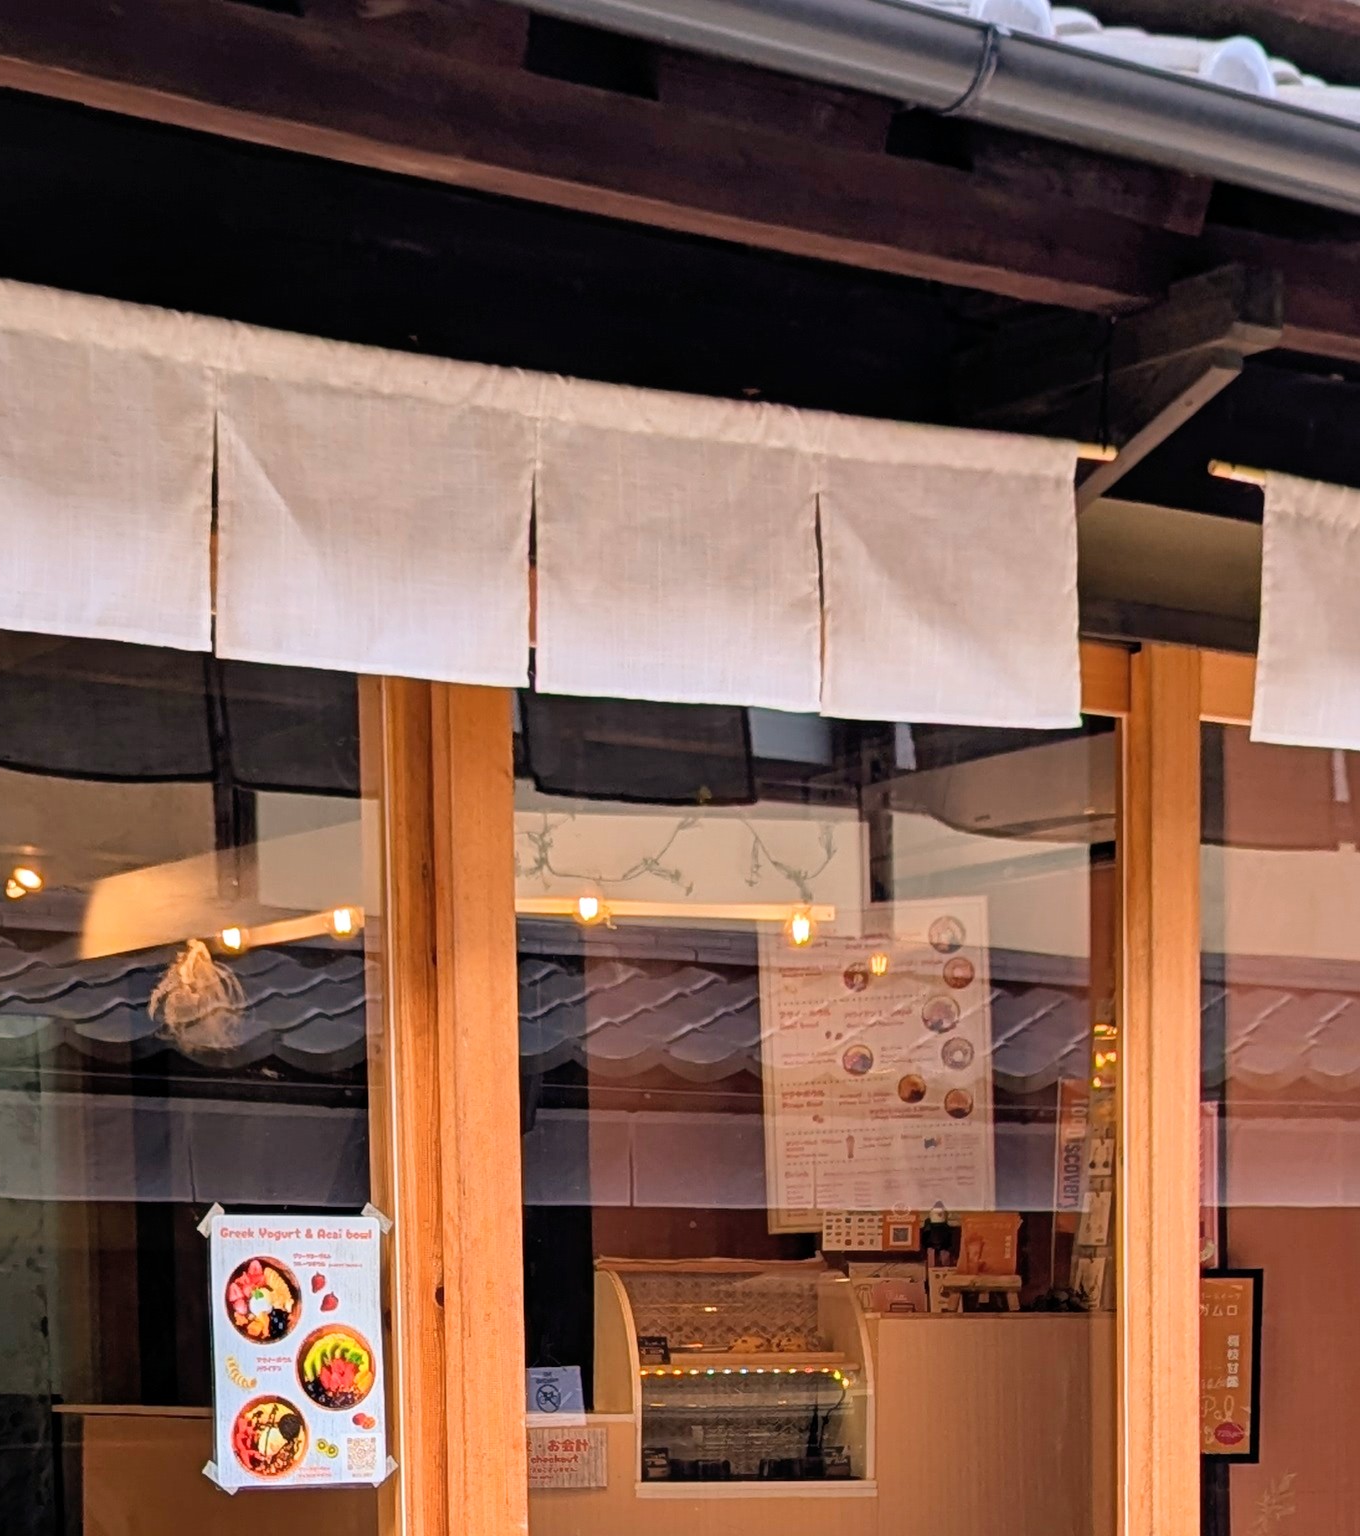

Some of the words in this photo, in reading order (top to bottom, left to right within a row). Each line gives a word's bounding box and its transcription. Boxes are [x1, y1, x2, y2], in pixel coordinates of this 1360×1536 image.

[220, 1227, 255, 1239] Greek
[258, 1228, 302, 1241] Yogurt
[304, 1228, 313, 1239] &
[317, 1228, 342, 1239] Acai
[346, 1229, 372, 1240] bowl
